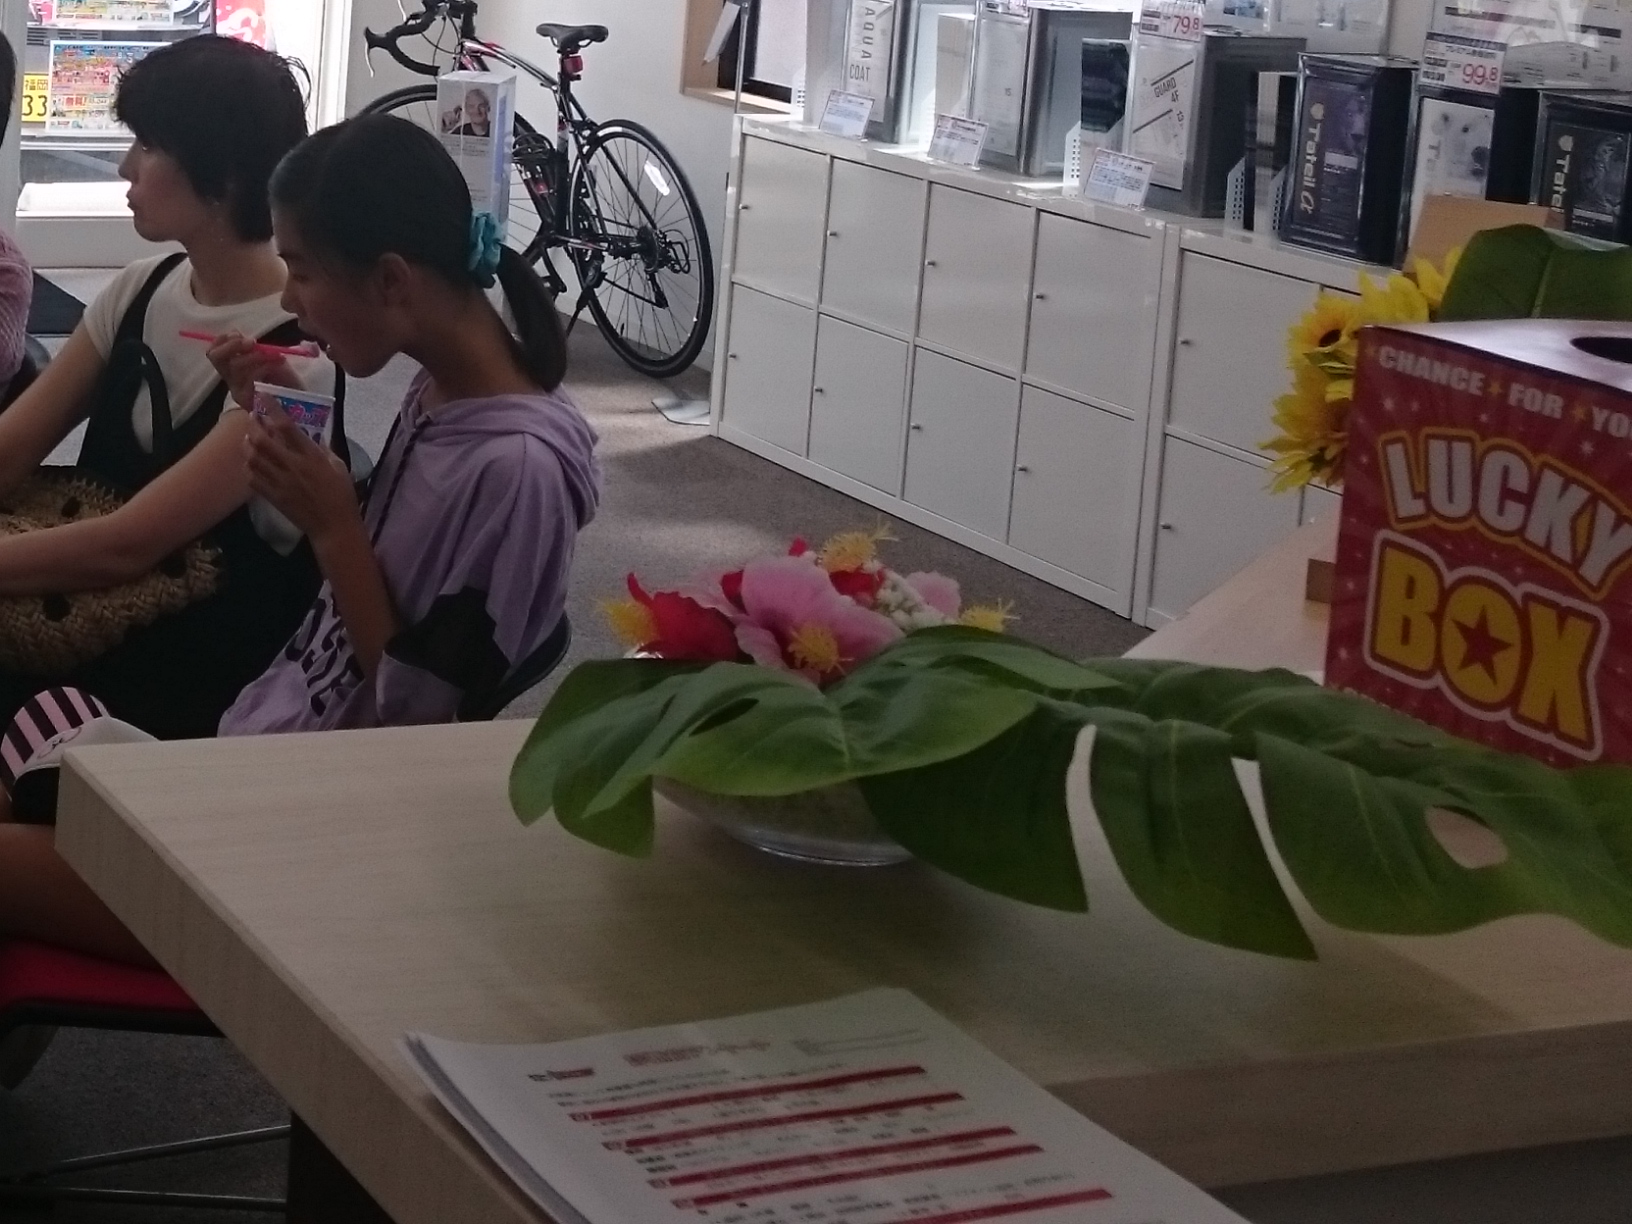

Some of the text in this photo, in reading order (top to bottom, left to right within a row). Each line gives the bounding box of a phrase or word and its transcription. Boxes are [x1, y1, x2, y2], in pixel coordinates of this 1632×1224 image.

[1379, 345, 1484, 396] CHANCE
[1507, 382, 1564, 419] FOR
[1381, 433, 1632, 593] LUCKY
[1370, 540, 1600, 750] BOX
